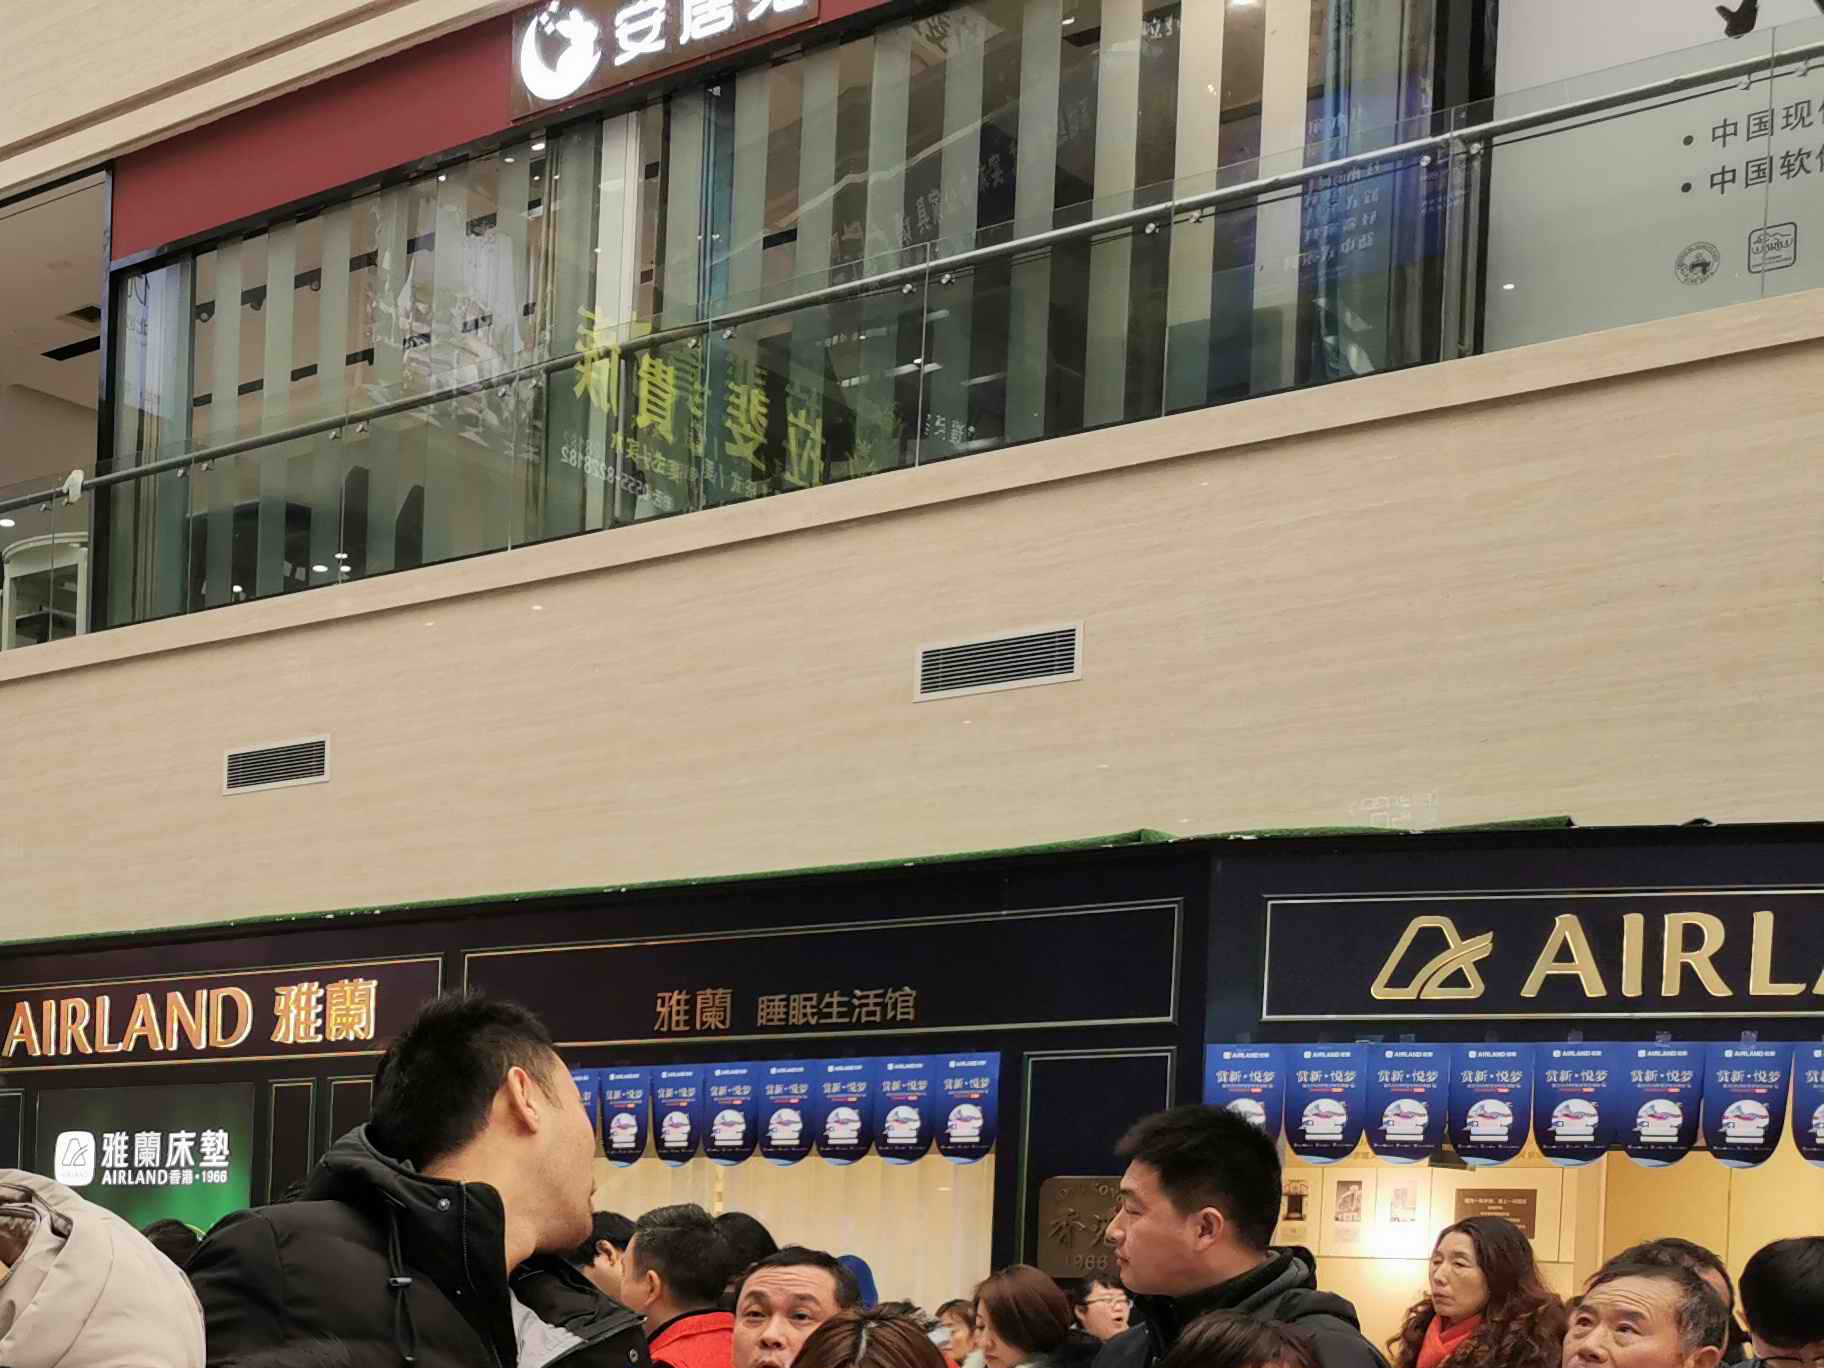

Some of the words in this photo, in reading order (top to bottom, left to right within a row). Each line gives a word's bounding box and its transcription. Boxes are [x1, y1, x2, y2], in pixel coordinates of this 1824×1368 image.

[1711, 99, 1824, 150] 中国现
[1709, 143, 1824, 196] 中国软
[1520, 910, 1824, 998] AIRL
[3, 985, 255, 1058] AIRLAND
[270, 976, 380, 1046] 雅蘭
[653, 988, 733, 1032] 雅蘭
[756, 985, 918, 1027] 睡眠生活馆
[101, 1128, 230, 1168] 雅蘭床墊
